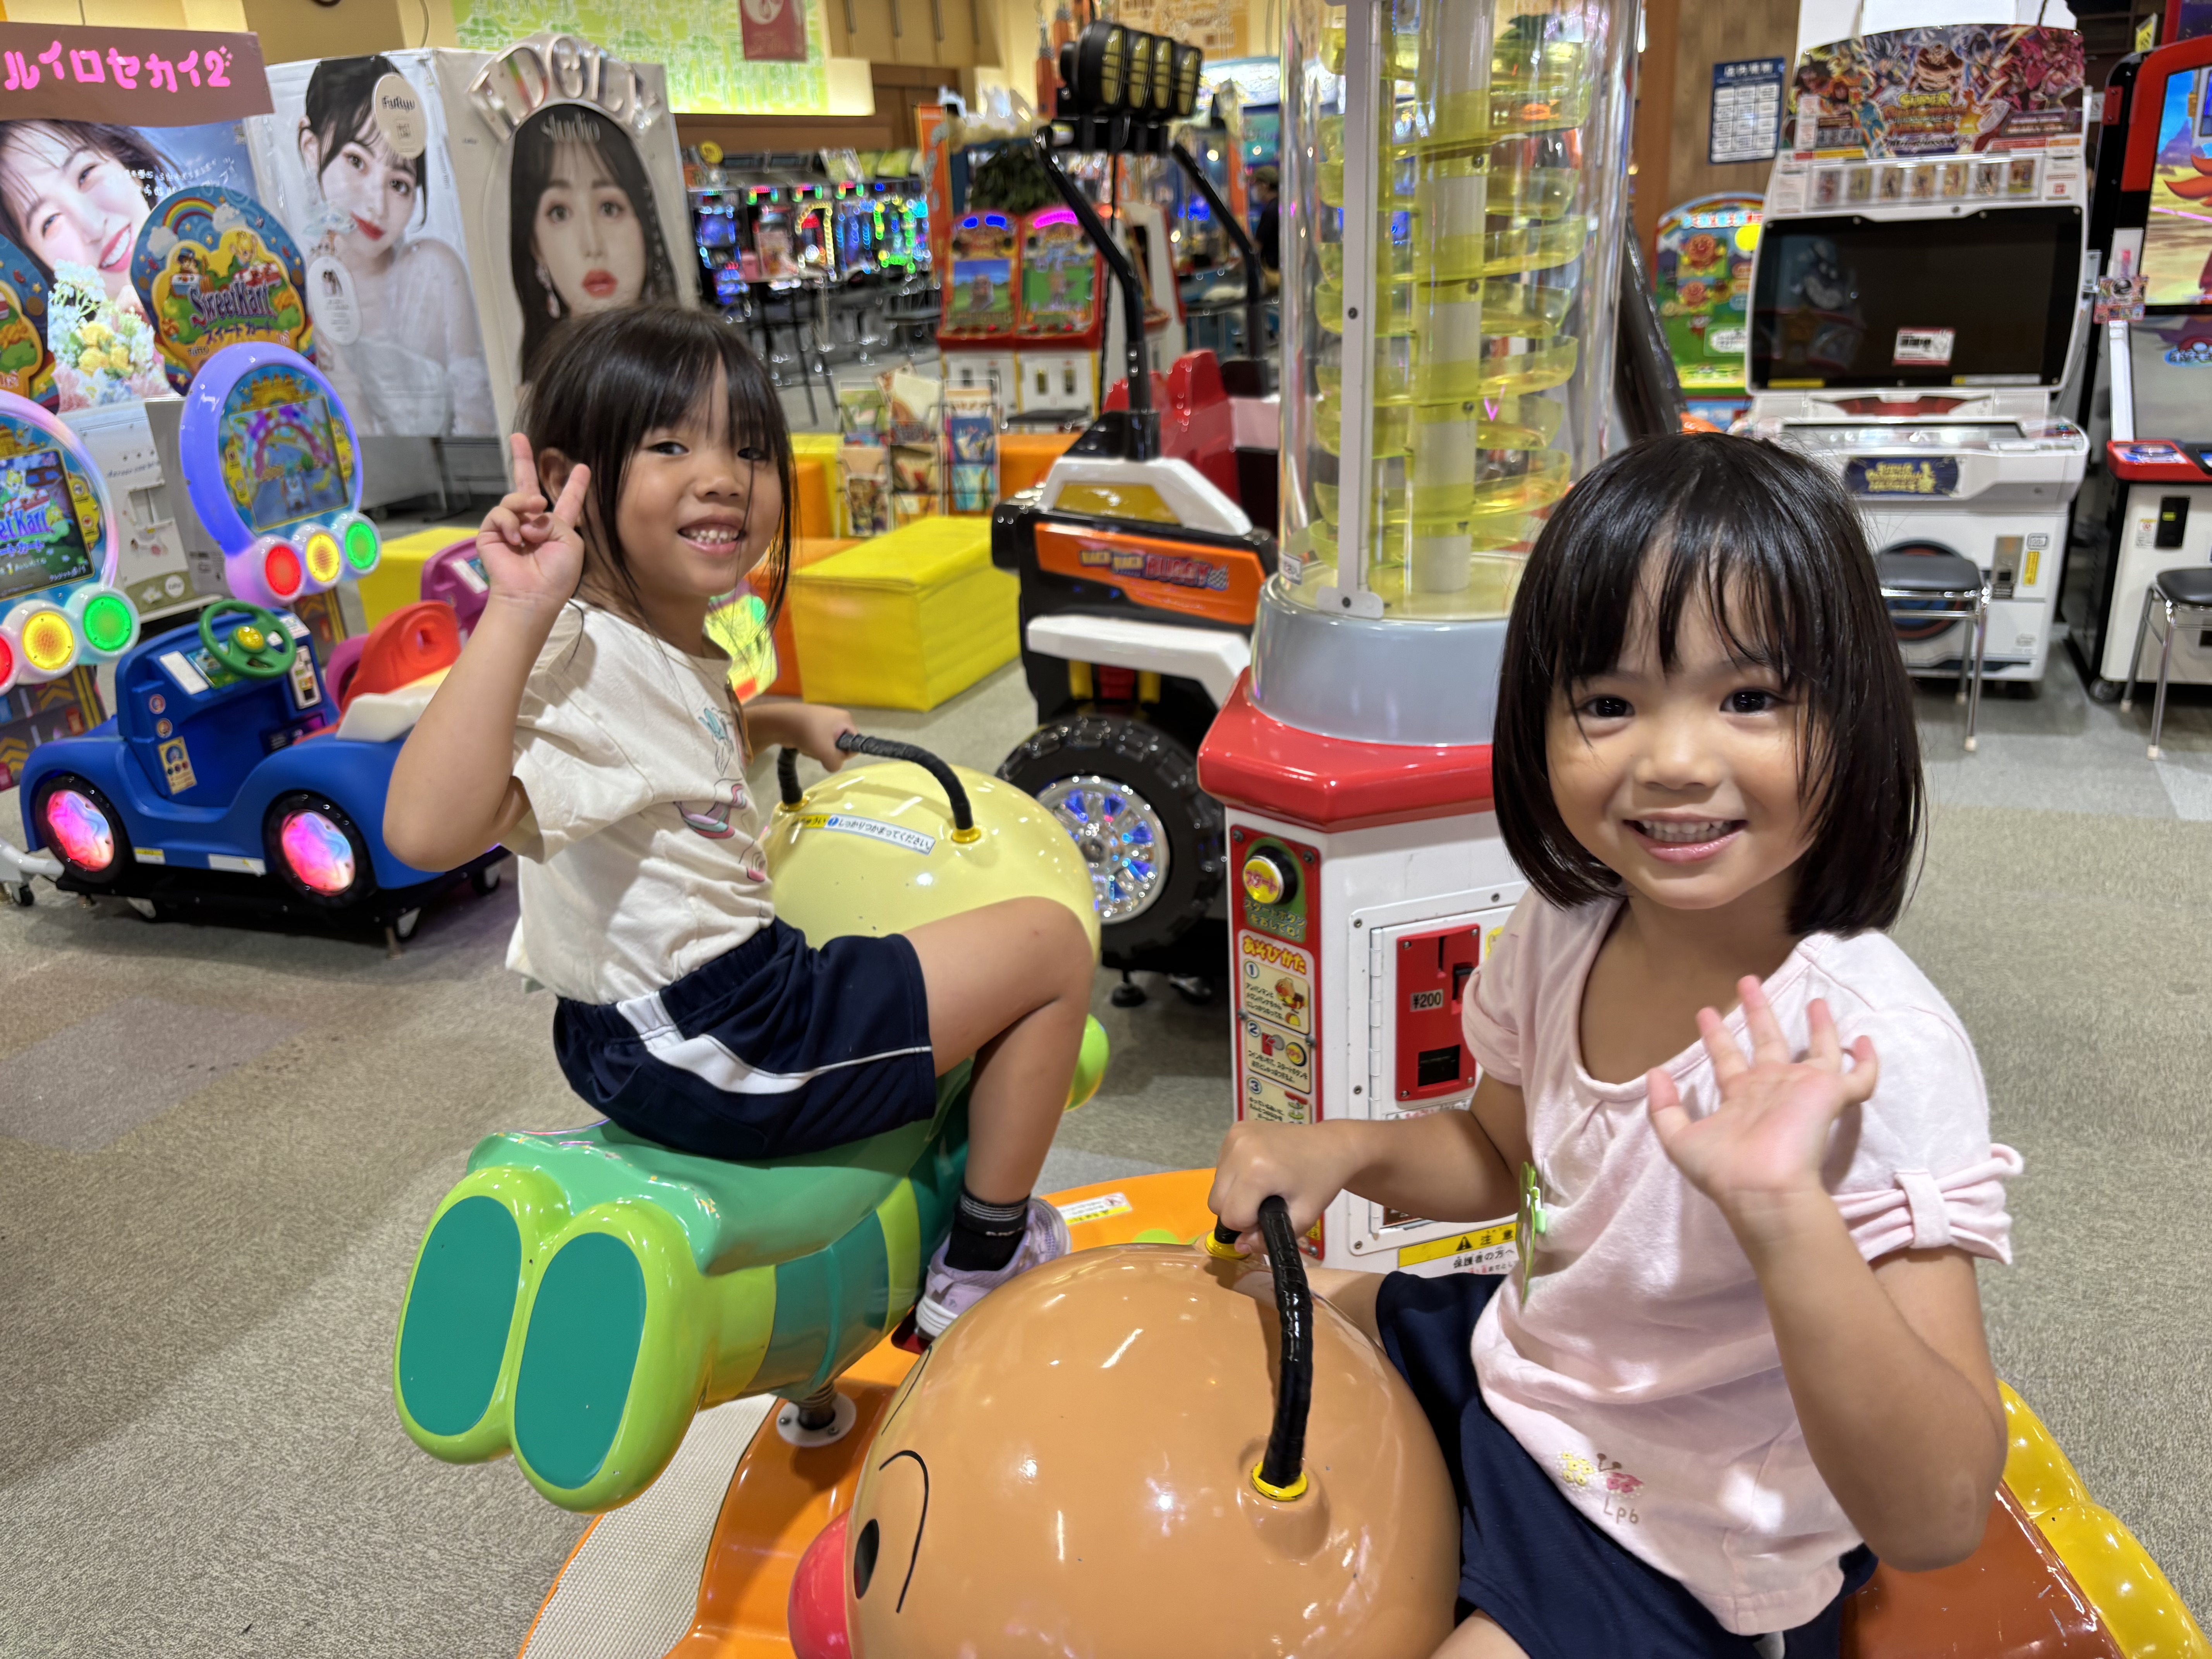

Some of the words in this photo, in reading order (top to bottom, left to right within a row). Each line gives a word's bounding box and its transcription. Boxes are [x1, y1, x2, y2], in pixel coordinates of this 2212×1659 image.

[541, 112, 600, 143] studio
[1245, 869, 1278, 894] スタート
[1244, 897, 1306, 927] スタートボタン
[1243, 934, 1306, 975] あそびかた
[1249, 964, 1254, 976] 1
[1413, 992, 1441, 1009] ¥200
[1250, 1022, 1257, 1034] 2
[1250, 1080, 1259, 1092] 3
[1480, 1229, 1514, 1245] 注意
[1453, 1249, 1515, 1269] 保護者の方へ
